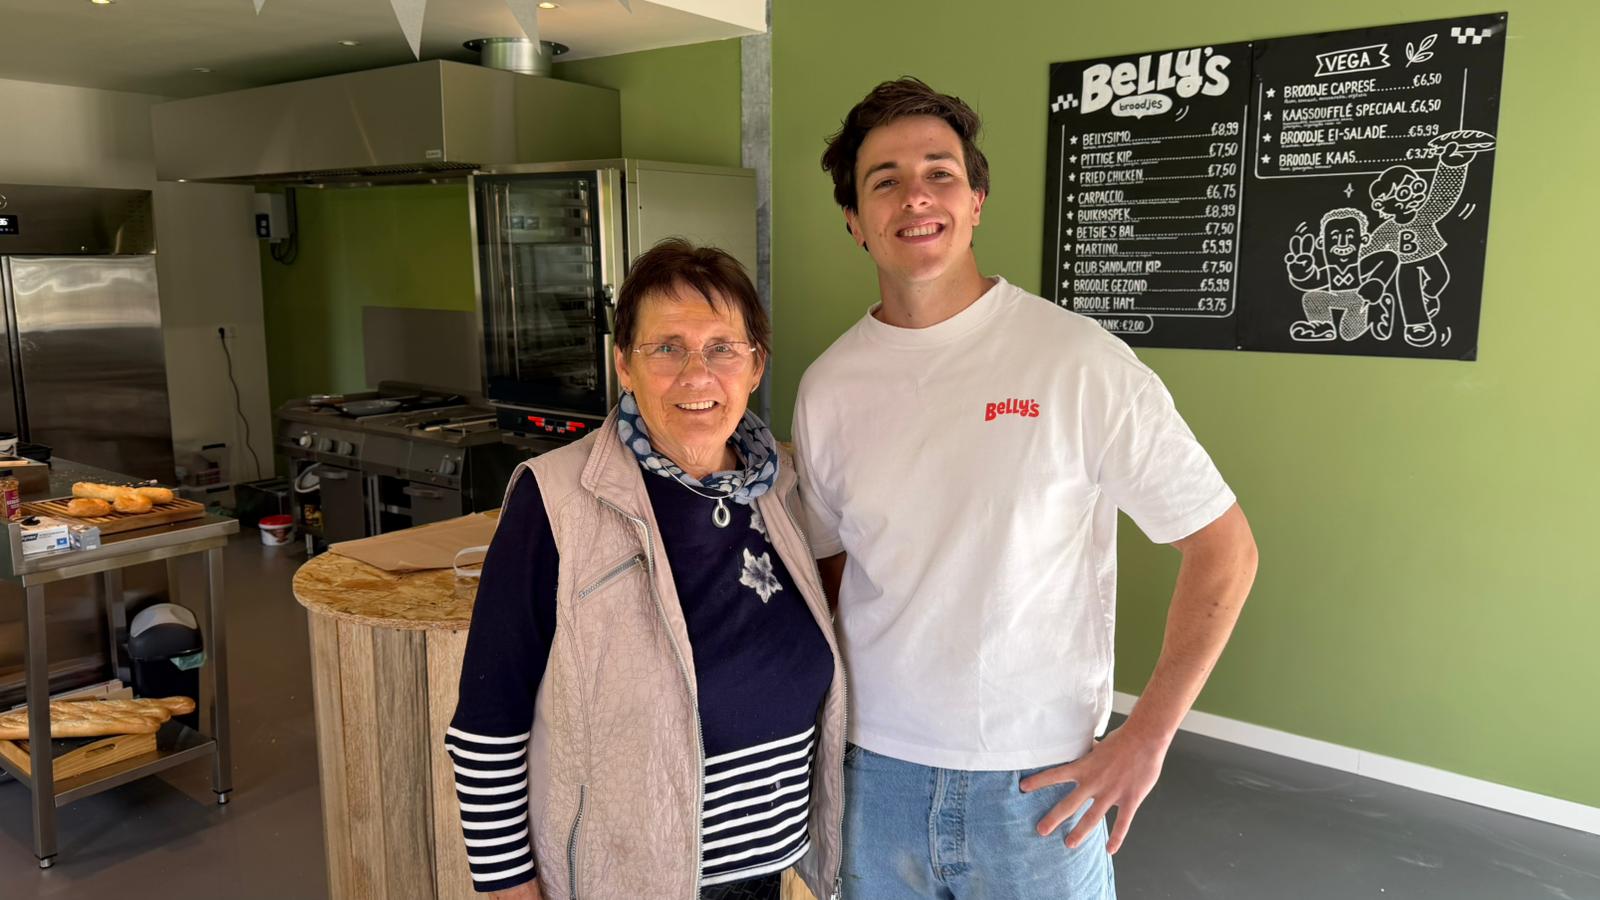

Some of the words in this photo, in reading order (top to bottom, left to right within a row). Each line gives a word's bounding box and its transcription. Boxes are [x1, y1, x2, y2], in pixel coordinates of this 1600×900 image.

[1324, 51, 1371, 72] VEGA
[1283, 83, 1329, 98] BROODJE
[1330, 79, 1376, 96] CAPRESE
[1119, 99, 1163, 111] broodjes
[1355, 101, 1408, 117] SPECIAAL
[1280, 129, 1325, 145] BROODJE
[1328, 124, 1388, 142] EI-SALADE
[1080, 151, 1115, 166] PITTIGE
[1116, 150, 1133, 163] KIP
[1279, 152, 1322, 167] BROODJE
[1326, 150, 1356, 165] KAAS
[1080, 170, 1106, 184] FRIED
[1107, 169, 1143, 182] CHICKEN
[1078, 190, 1124, 205] CARPACCIO
[1076, 225, 1117, 239] BETSIE'S
[1119, 225, 1134, 237] BAL
[1075, 243, 1118, 255] MARTINO
[1399, 230, 1418, 255] B
[1074, 261, 1098, 274] CLUB
[1098, 260, 1142, 273] SANDWICH
[1145, 260, 1162, 273] KIP
[1073, 279, 1110, 292] BROODJE
[1110, 279, 1148, 292] GEZOND
[1073, 297, 1111, 310] BROODJE
[1112, 296, 1135, 310] HAM
